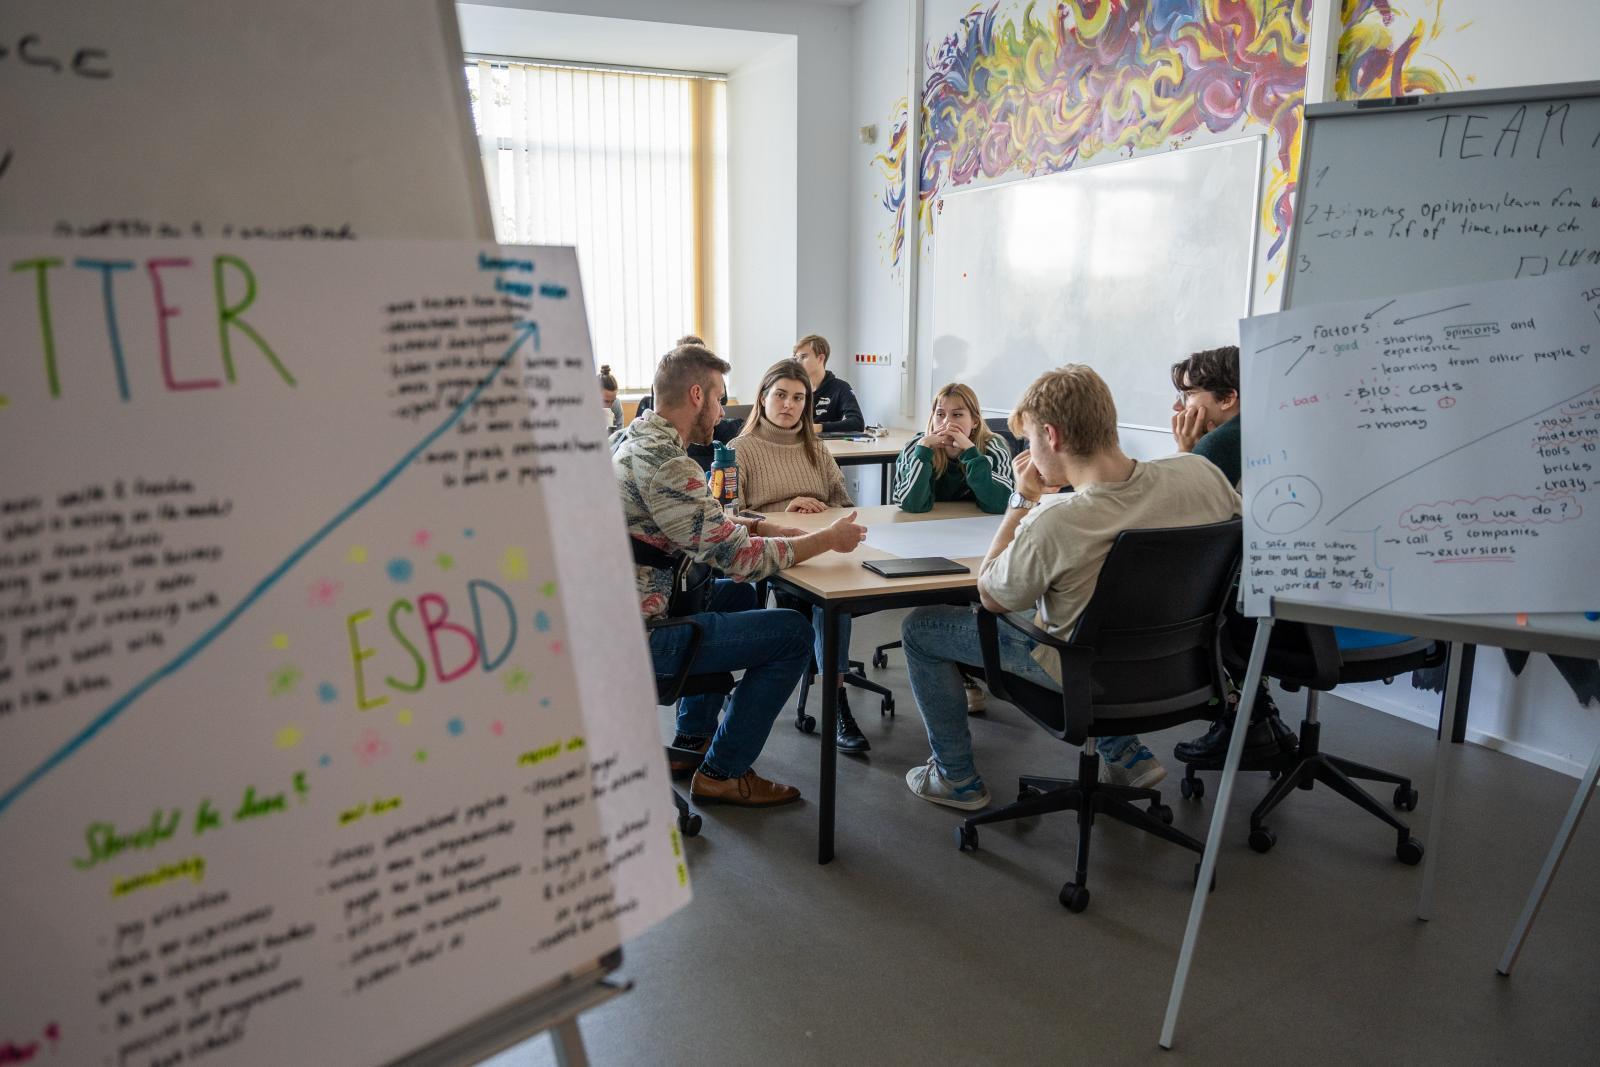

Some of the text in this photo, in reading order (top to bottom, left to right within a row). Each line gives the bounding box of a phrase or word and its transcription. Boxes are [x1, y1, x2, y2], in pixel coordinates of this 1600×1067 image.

[1427, 103, 1570, 159] TEAM
[0, 254, 298, 406] TTER
[1383, 318, 1536, 346] sharing opinions and
[1383, 344, 1460, 358] experience
[1381, 348, 1575, 375] learning from other people
[1380, 404, 1426, 414] time
[1374, 419, 1428, 430] money
[1541, 417, 1572, 427] now
[1536, 443, 1596, 458] tools to
[1543, 462, 1592, 475] bricks
[1544, 478, 1586, 493] crazy
[1456, 511, 1479, 521] can
[1492, 508, 1517, 518] we
[1406, 526, 1541, 545] call 5 companies
[1266, 540, 1288, 549] safe
[1436, 545, 1518, 558] excursions
[1281, 567, 1299, 577] and
[1332, 567, 1356, 578] have
[1360, 567, 1374, 580] to
[1252, 583, 1265, 595] be
[1273, 580, 1321, 593] worried
[1328, 581, 1343, 589] to
[345, 578, 519, 712] ESBD
